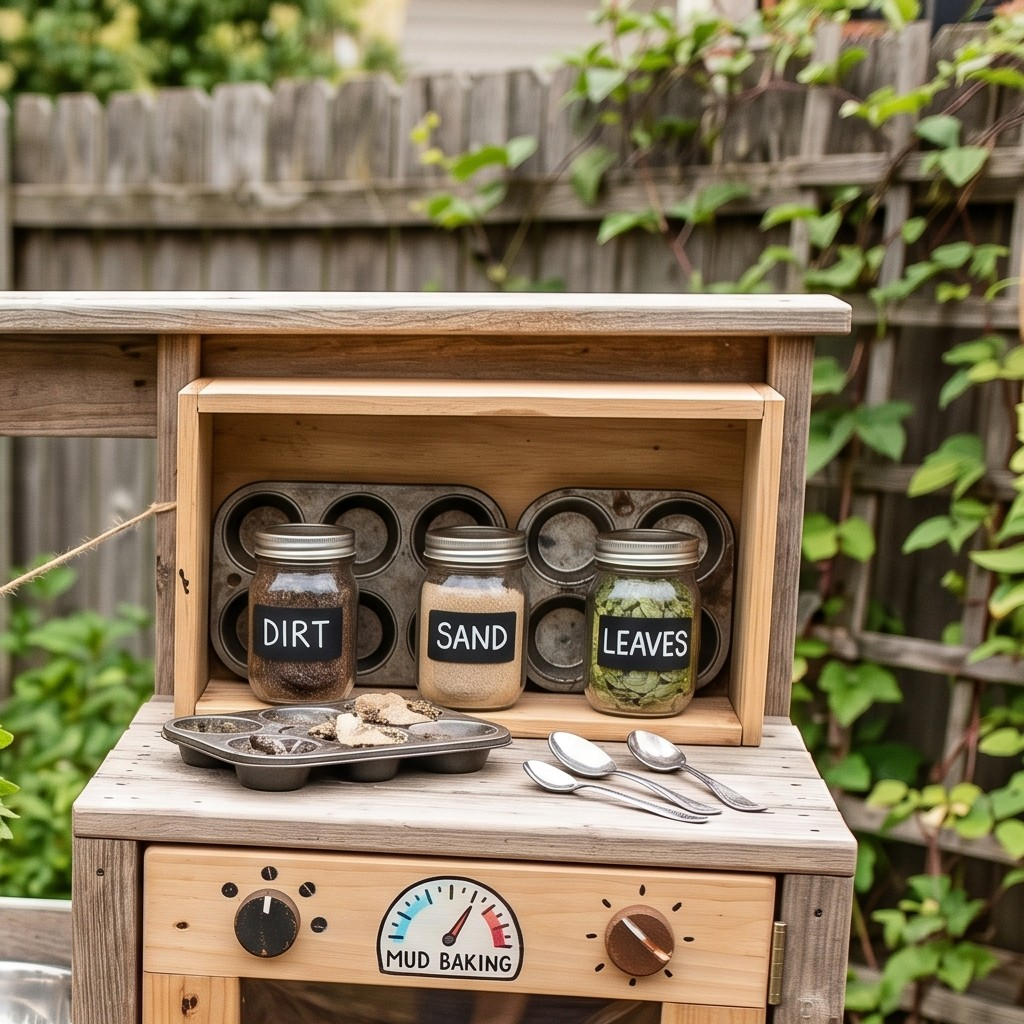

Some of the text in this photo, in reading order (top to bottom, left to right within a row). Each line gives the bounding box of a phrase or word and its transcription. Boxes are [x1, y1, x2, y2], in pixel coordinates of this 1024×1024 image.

[262, 618, 330, 650] DIRT
[436, 621, 508, 651] SAND
[602, 627, 689, 659] LEAVES
[385, 949, 513, 973] MUD BAKING
